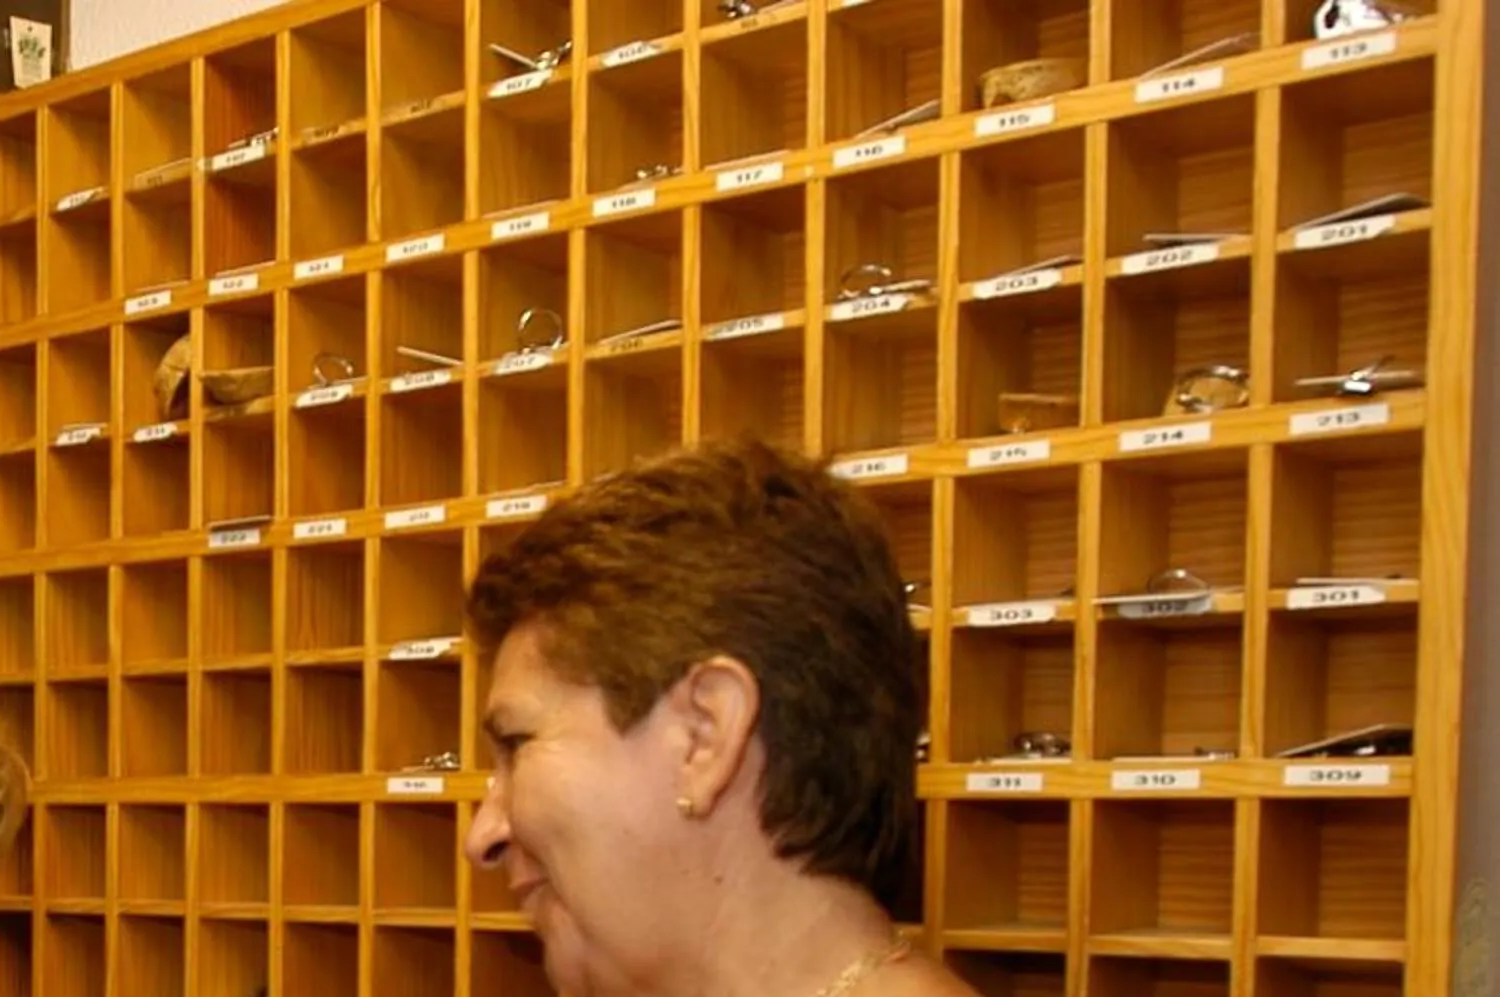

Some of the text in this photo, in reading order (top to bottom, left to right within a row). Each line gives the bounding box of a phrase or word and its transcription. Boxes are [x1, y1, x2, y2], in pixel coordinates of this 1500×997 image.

[1329, 41, 1369, 60] 113
[1161, 76, 1198, 94] 114
[999, 112, 1031, 128] 115
[736, 169, 763, 184] 117
[1322, 223, 1370, 241] 201
[1146, 247, 1194, 267] 202
[995, 275, 1038, 292] 203
[851, 298, 891, 314] 204
[1317, 409, 1362, 427] 213
[1143, 428, 1186, 446] 214
[989, 445, 1028, 461] 215
[1312, 588, 1360, 603] 301
[989, 606, 1034, 622] 303
[1141, 599, 1188, 615] 302
[988, 775, 1022, 789] 311
[1135, 773, 1176, 787] 310
[1310, 767, 1363, 783] 309
